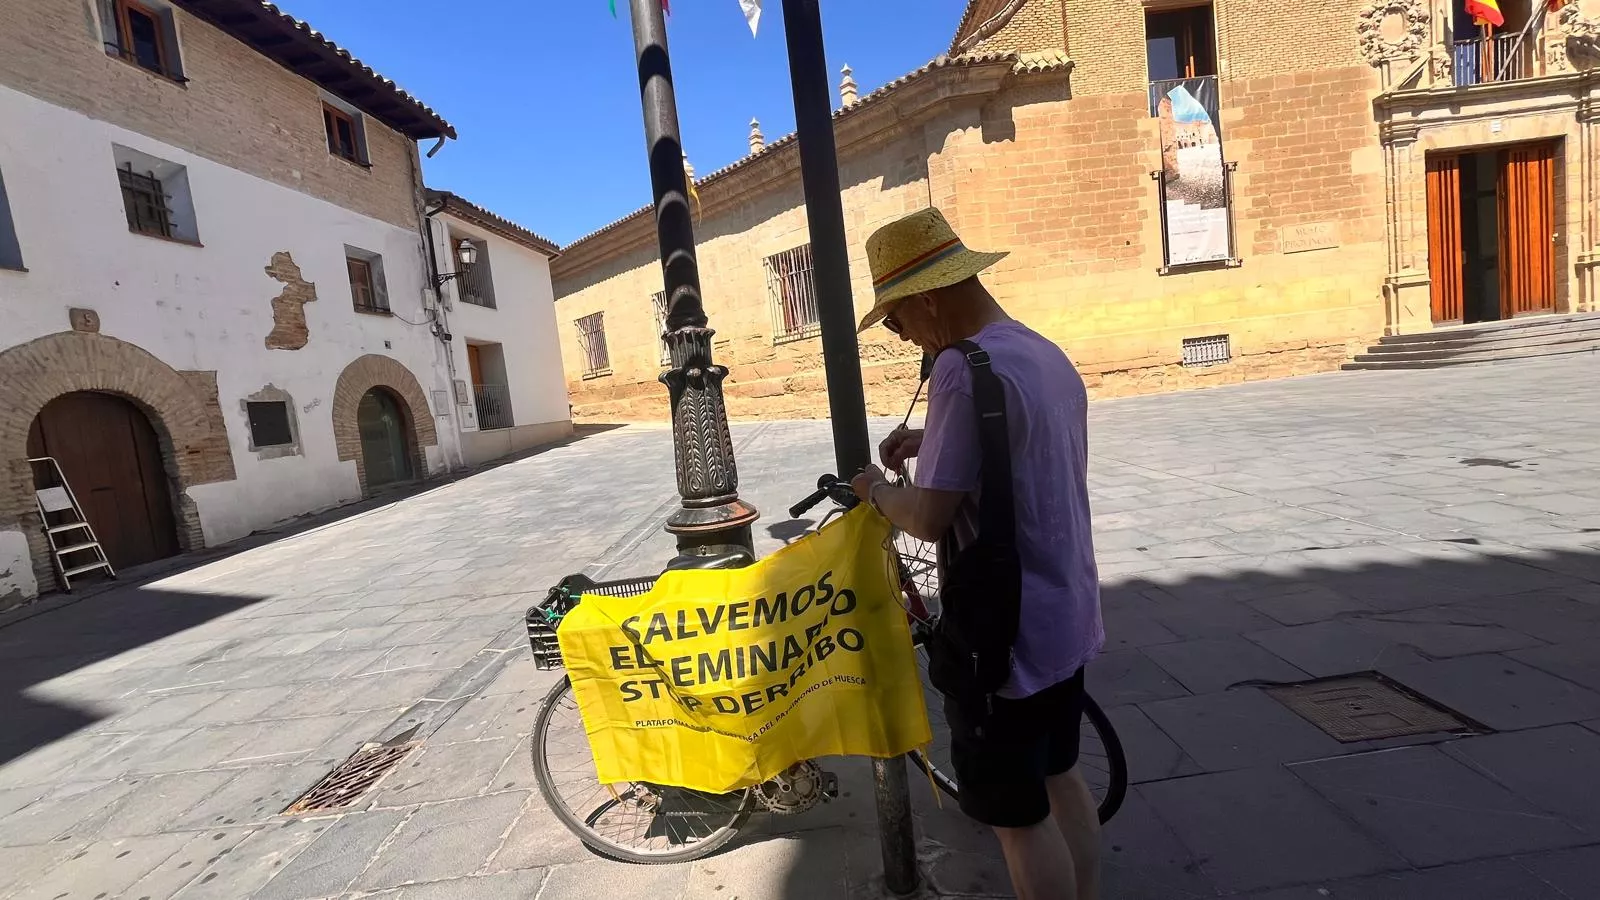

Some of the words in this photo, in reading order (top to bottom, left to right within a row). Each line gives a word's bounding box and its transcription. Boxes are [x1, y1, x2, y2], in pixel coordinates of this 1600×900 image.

[609, 645, 658, 671] EL
[655, 588, 857, 687] EMINARIO
[621, 570, 834, 645] SALVEMOS
[711, 627, 865, 715] DERRIBO
[759, 720, 775, 735] DEL
[821, 678, 834, 687] DE
[834, 674, 867, 686] HUESCA
